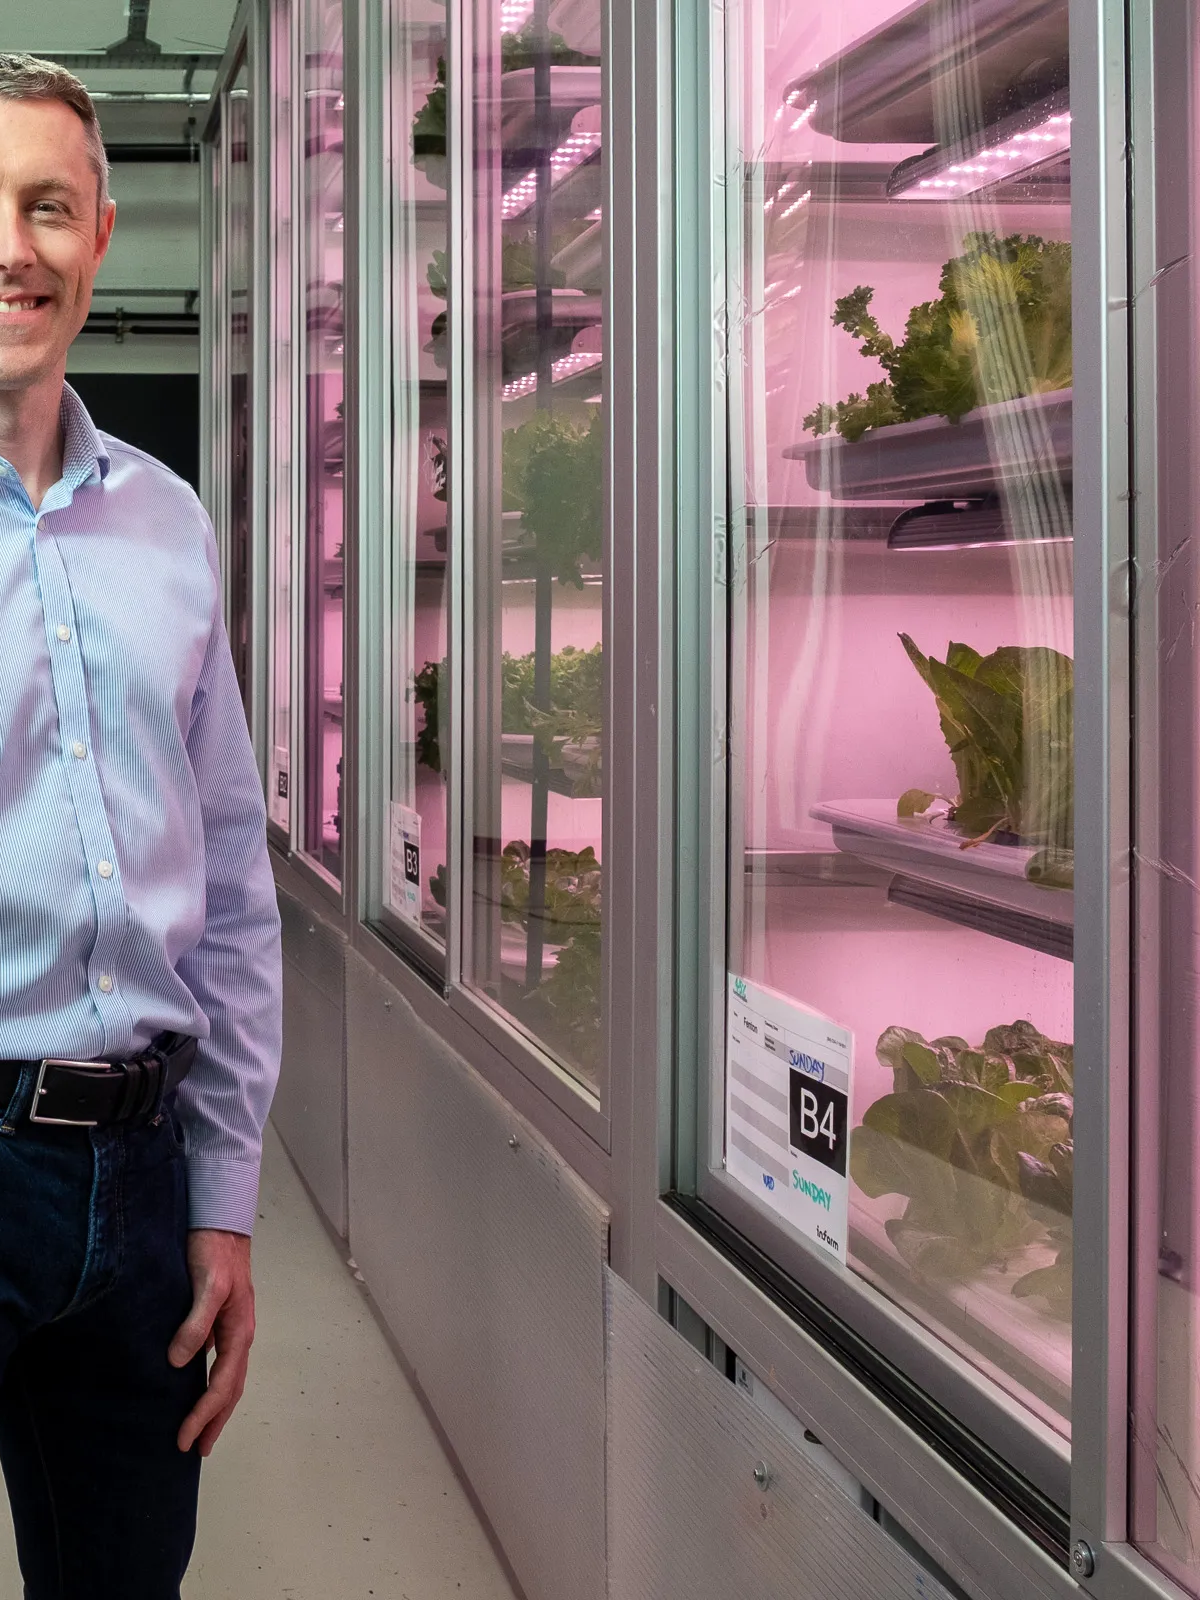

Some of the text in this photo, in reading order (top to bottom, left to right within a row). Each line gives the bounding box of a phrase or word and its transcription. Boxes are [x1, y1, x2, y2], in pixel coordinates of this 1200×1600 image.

[406, 848, 418, 876] B3
[743, 1016, 758, 1034] Fenton
[789, 1050, 825, 1083] SUNDAY
[800, 1087, 837, 1151] B4
[792, 1169, 831, 1212] SUNDAY
[816, 1225, 839, 1251] infarm
